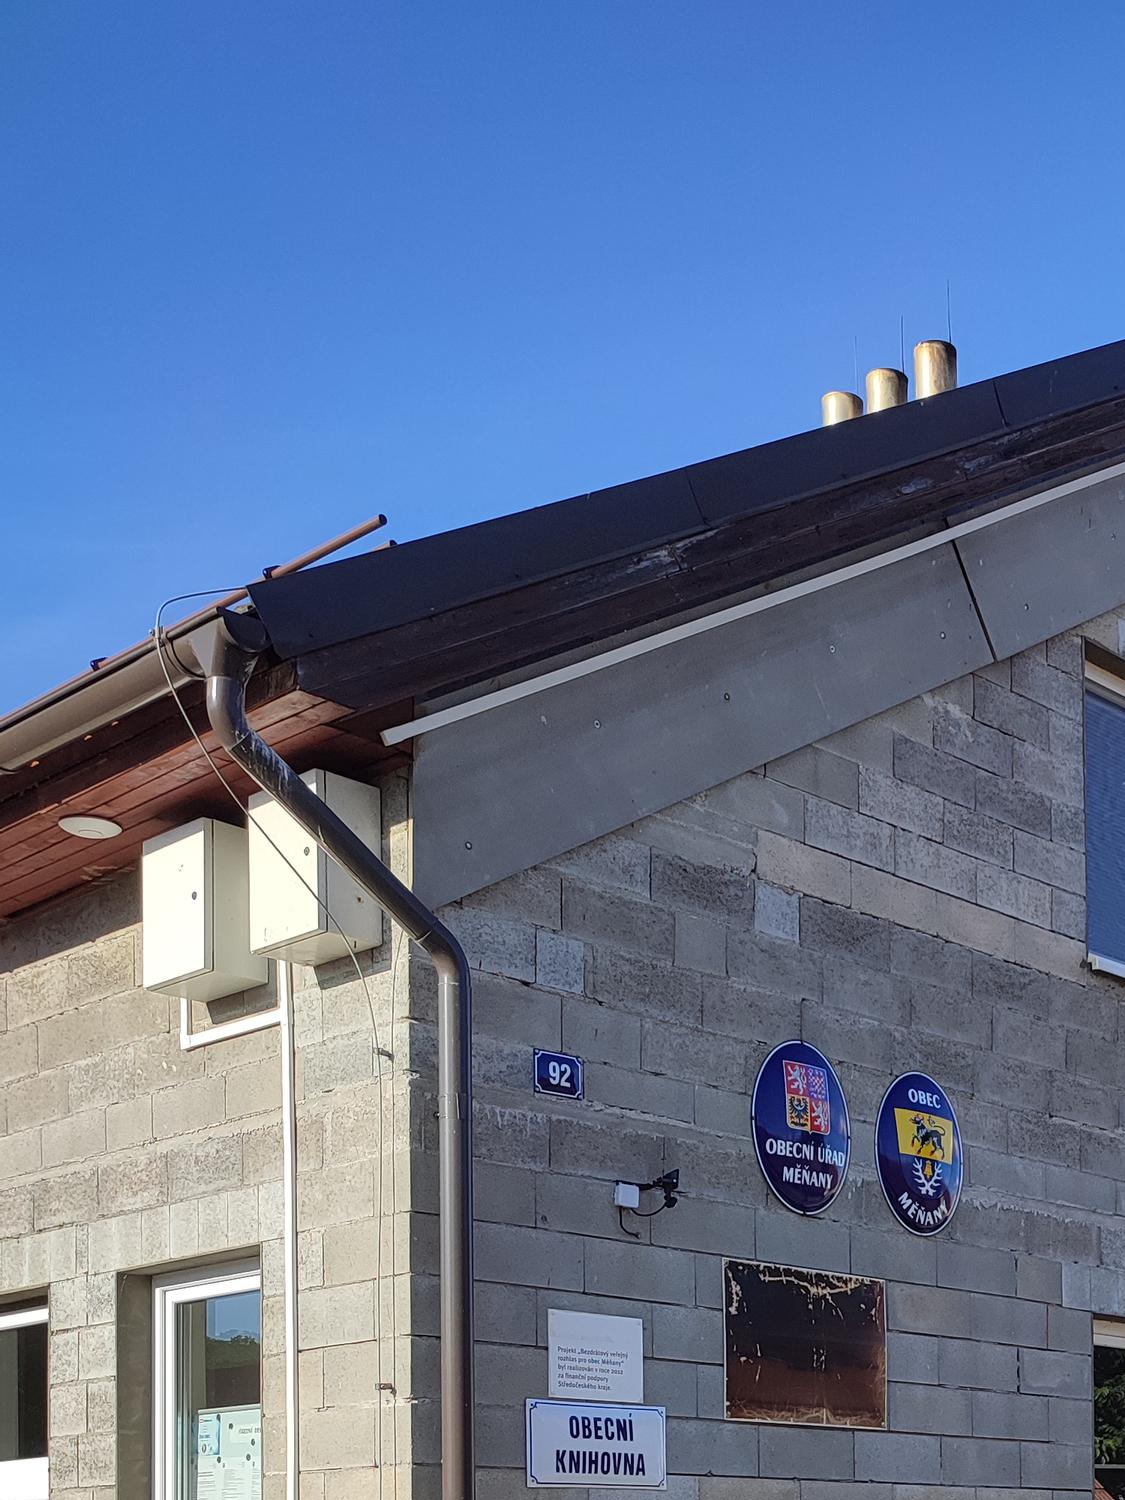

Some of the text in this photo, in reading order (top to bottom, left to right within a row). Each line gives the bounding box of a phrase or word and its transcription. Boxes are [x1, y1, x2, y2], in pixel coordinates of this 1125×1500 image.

[548, 1061, 571, 1088] 92
[908, 1088, 941, 1109] OBEC
[765, 1138, 846, 1167] OBECNÍ ÚŘAD
[782, 1163, 834, 1190] MĚŇANY
[898, 1191, 949, 1226] MĚŇANY
[558, 1346, 576, 1354] Projekt
[610, 1351, 628, 1359] veřejný
[567, 1364, 594, 1372] realizován
[587, 1375, 609, 1383] podpory
[558, 1381, 597, 1389] Středočeského
[569, 1412, 634, 1442] OBECNÍ
[555, 1449, 646, 1476] KNIHOVNA
